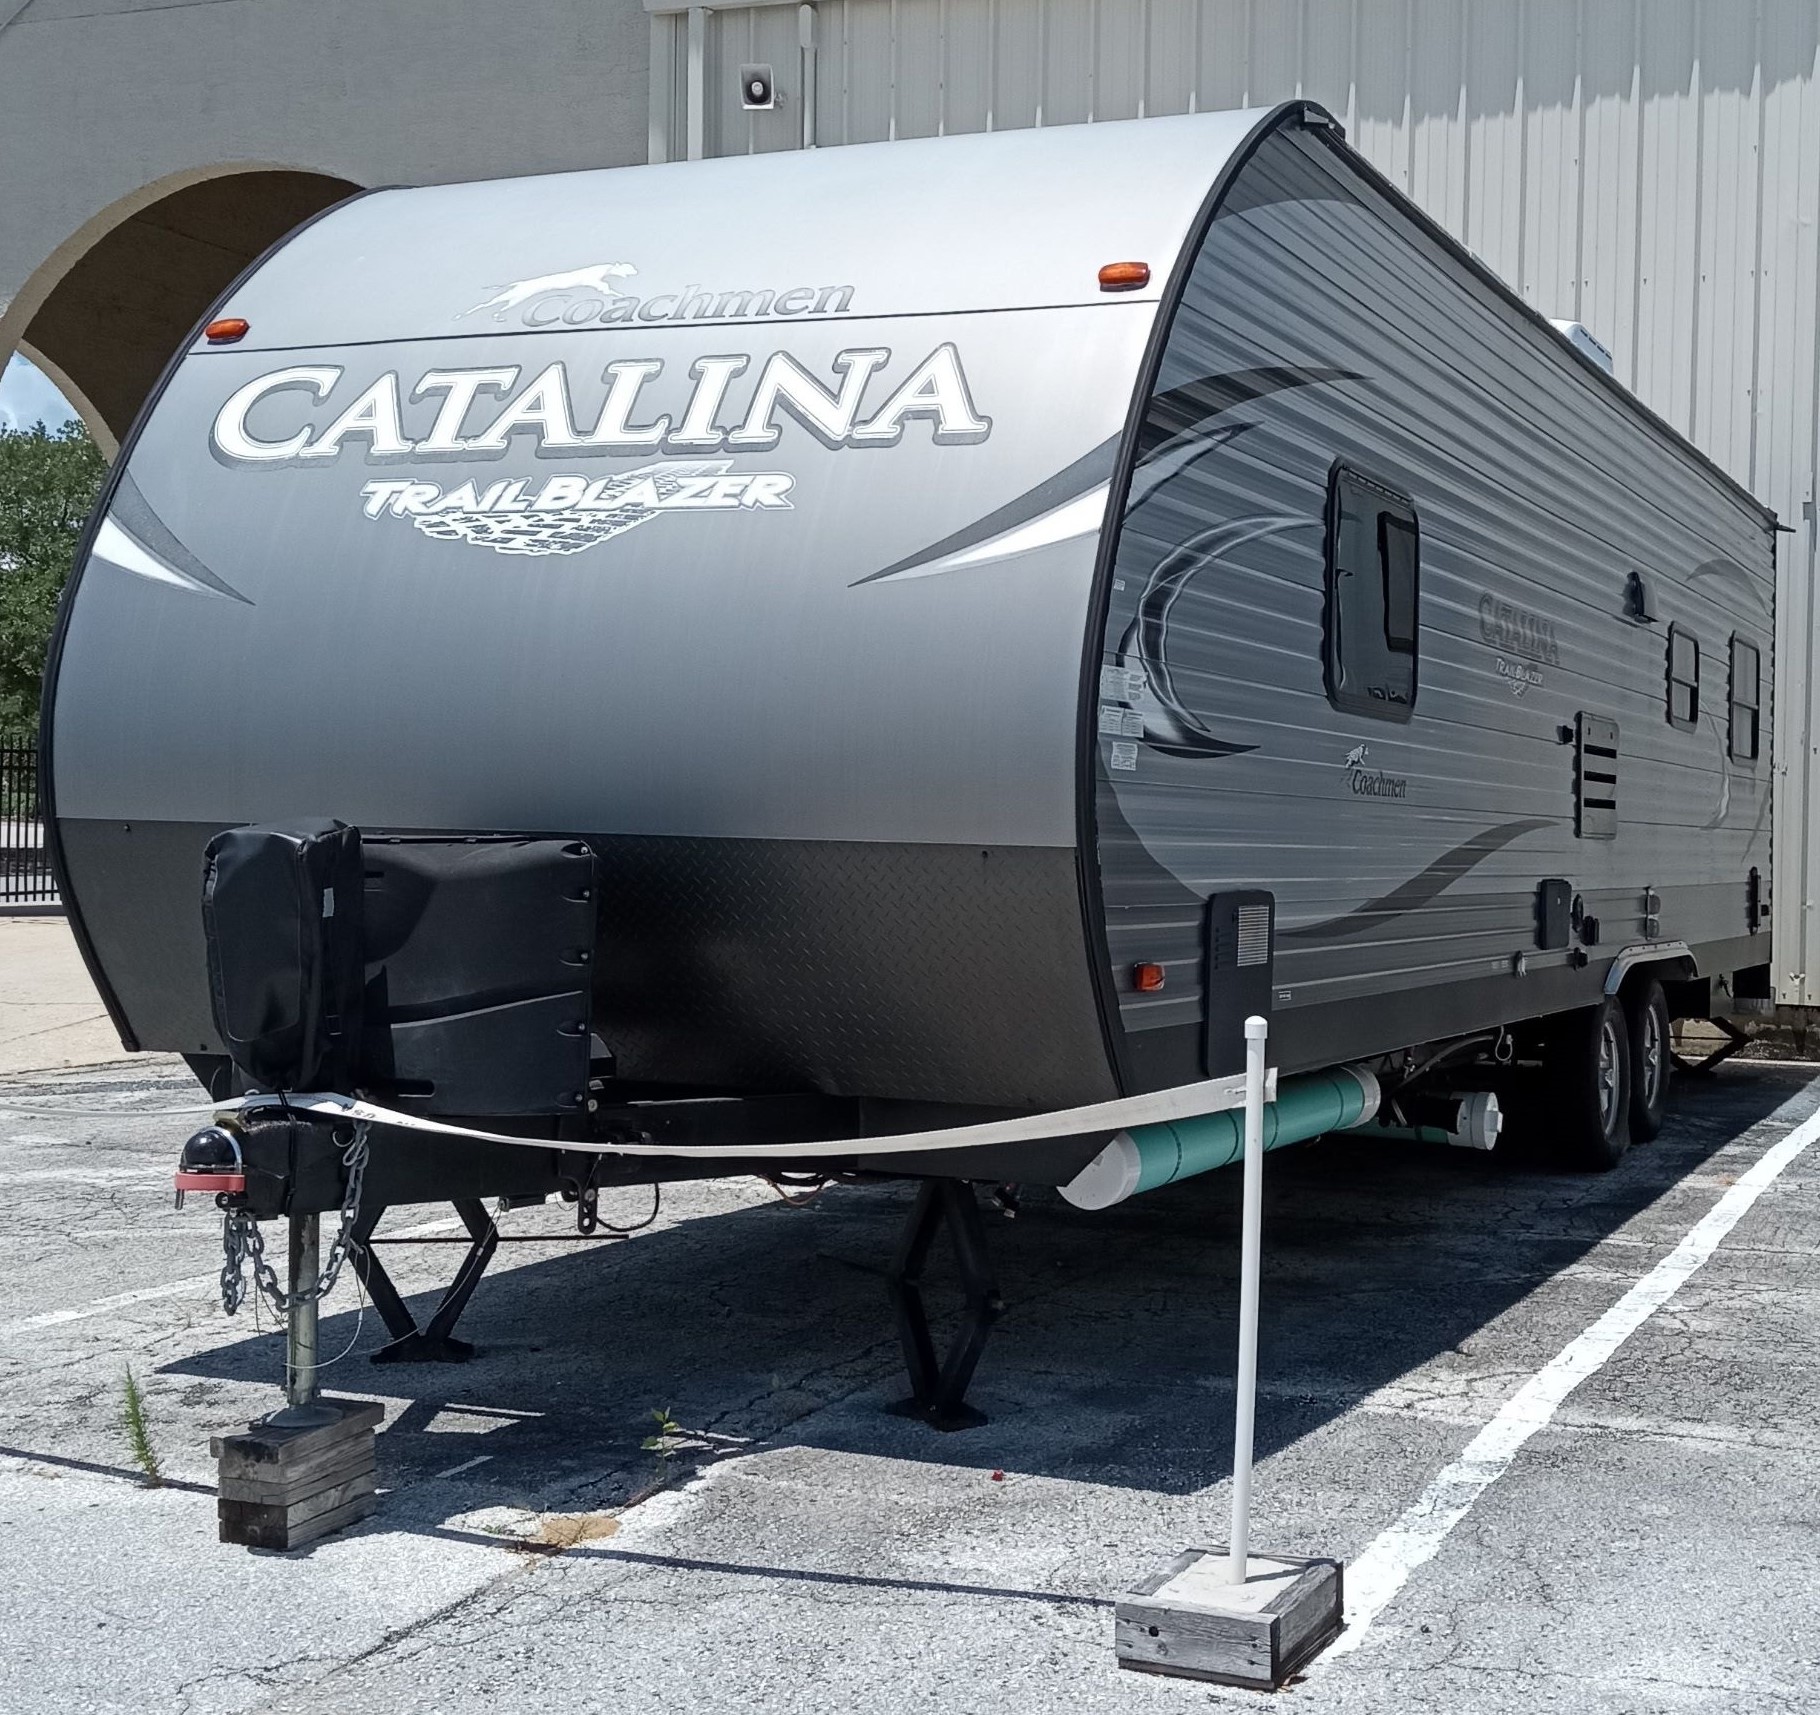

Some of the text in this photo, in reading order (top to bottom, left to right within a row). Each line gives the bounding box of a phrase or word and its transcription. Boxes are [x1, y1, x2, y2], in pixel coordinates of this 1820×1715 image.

[521, 284, 856, 328] Coachmen
[211, 342, 992, 468] CATALINA
[1479, 592, 1560, 666] CATALINA
[1352, 769, 1406, 798] Coachmen
